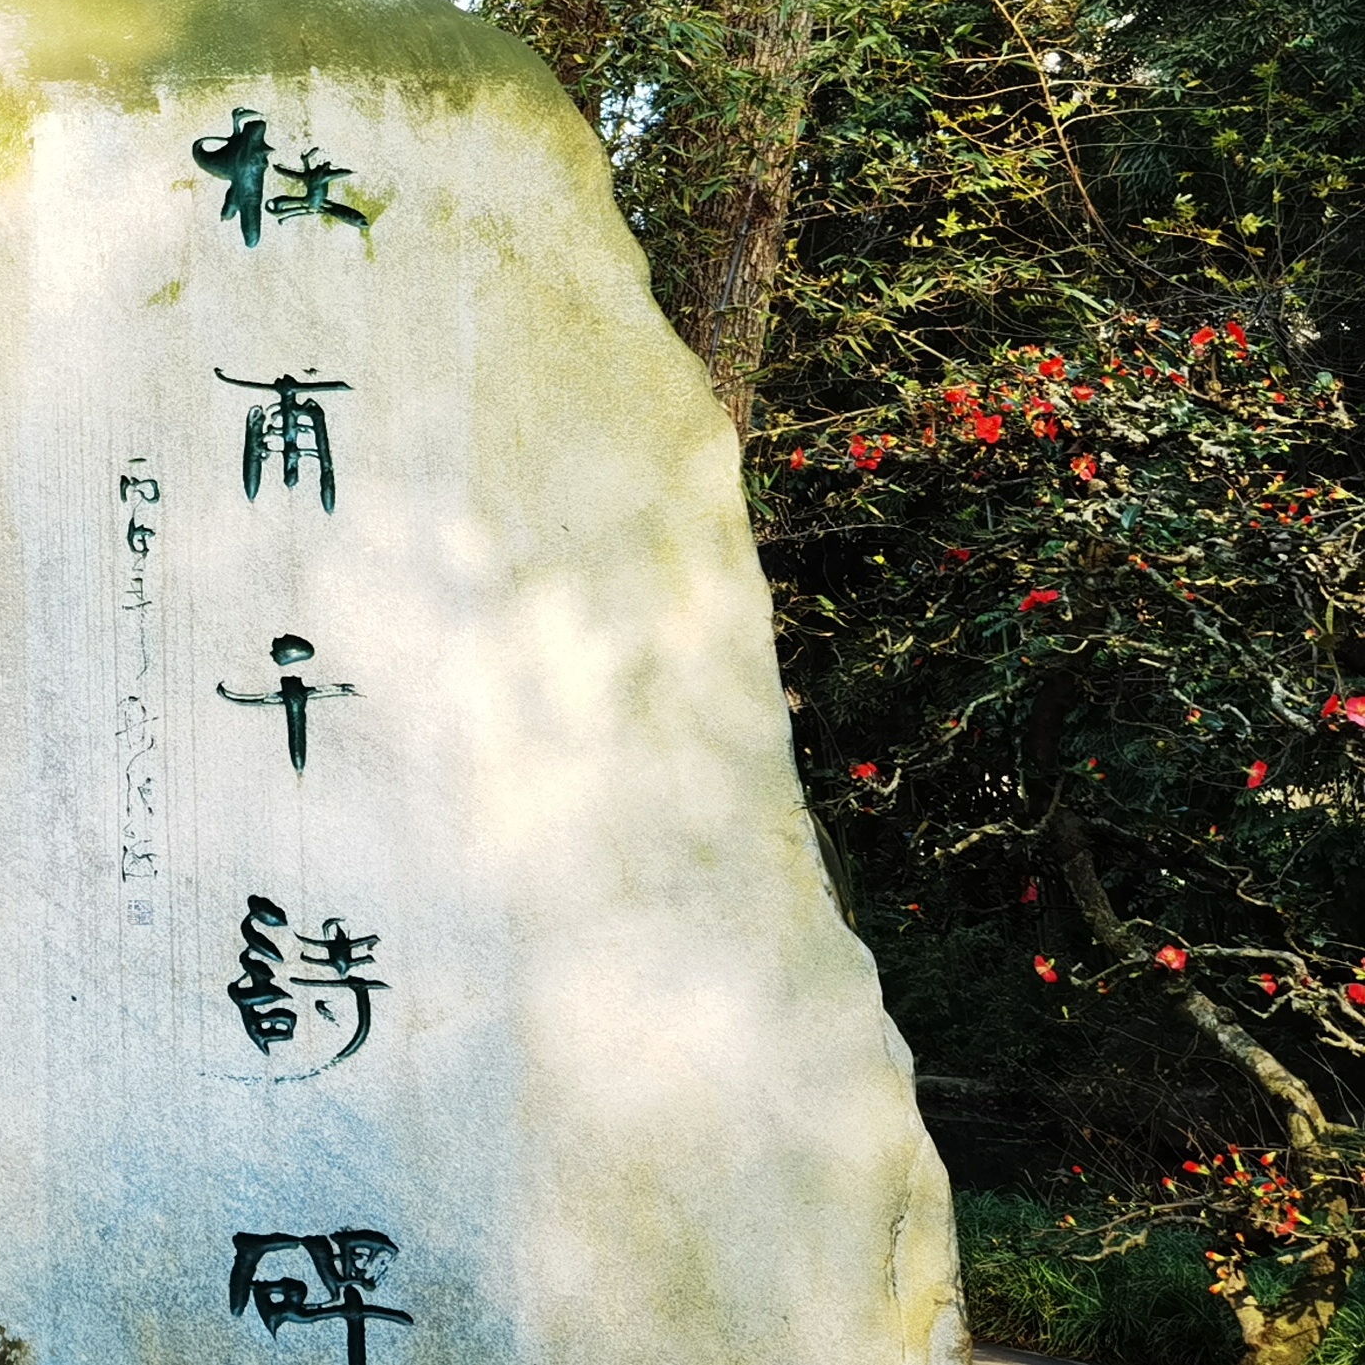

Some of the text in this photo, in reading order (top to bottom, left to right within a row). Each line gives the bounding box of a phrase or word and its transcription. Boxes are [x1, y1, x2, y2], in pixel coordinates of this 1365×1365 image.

[190, 107, 414, 1365] 杜甫千詩碑
